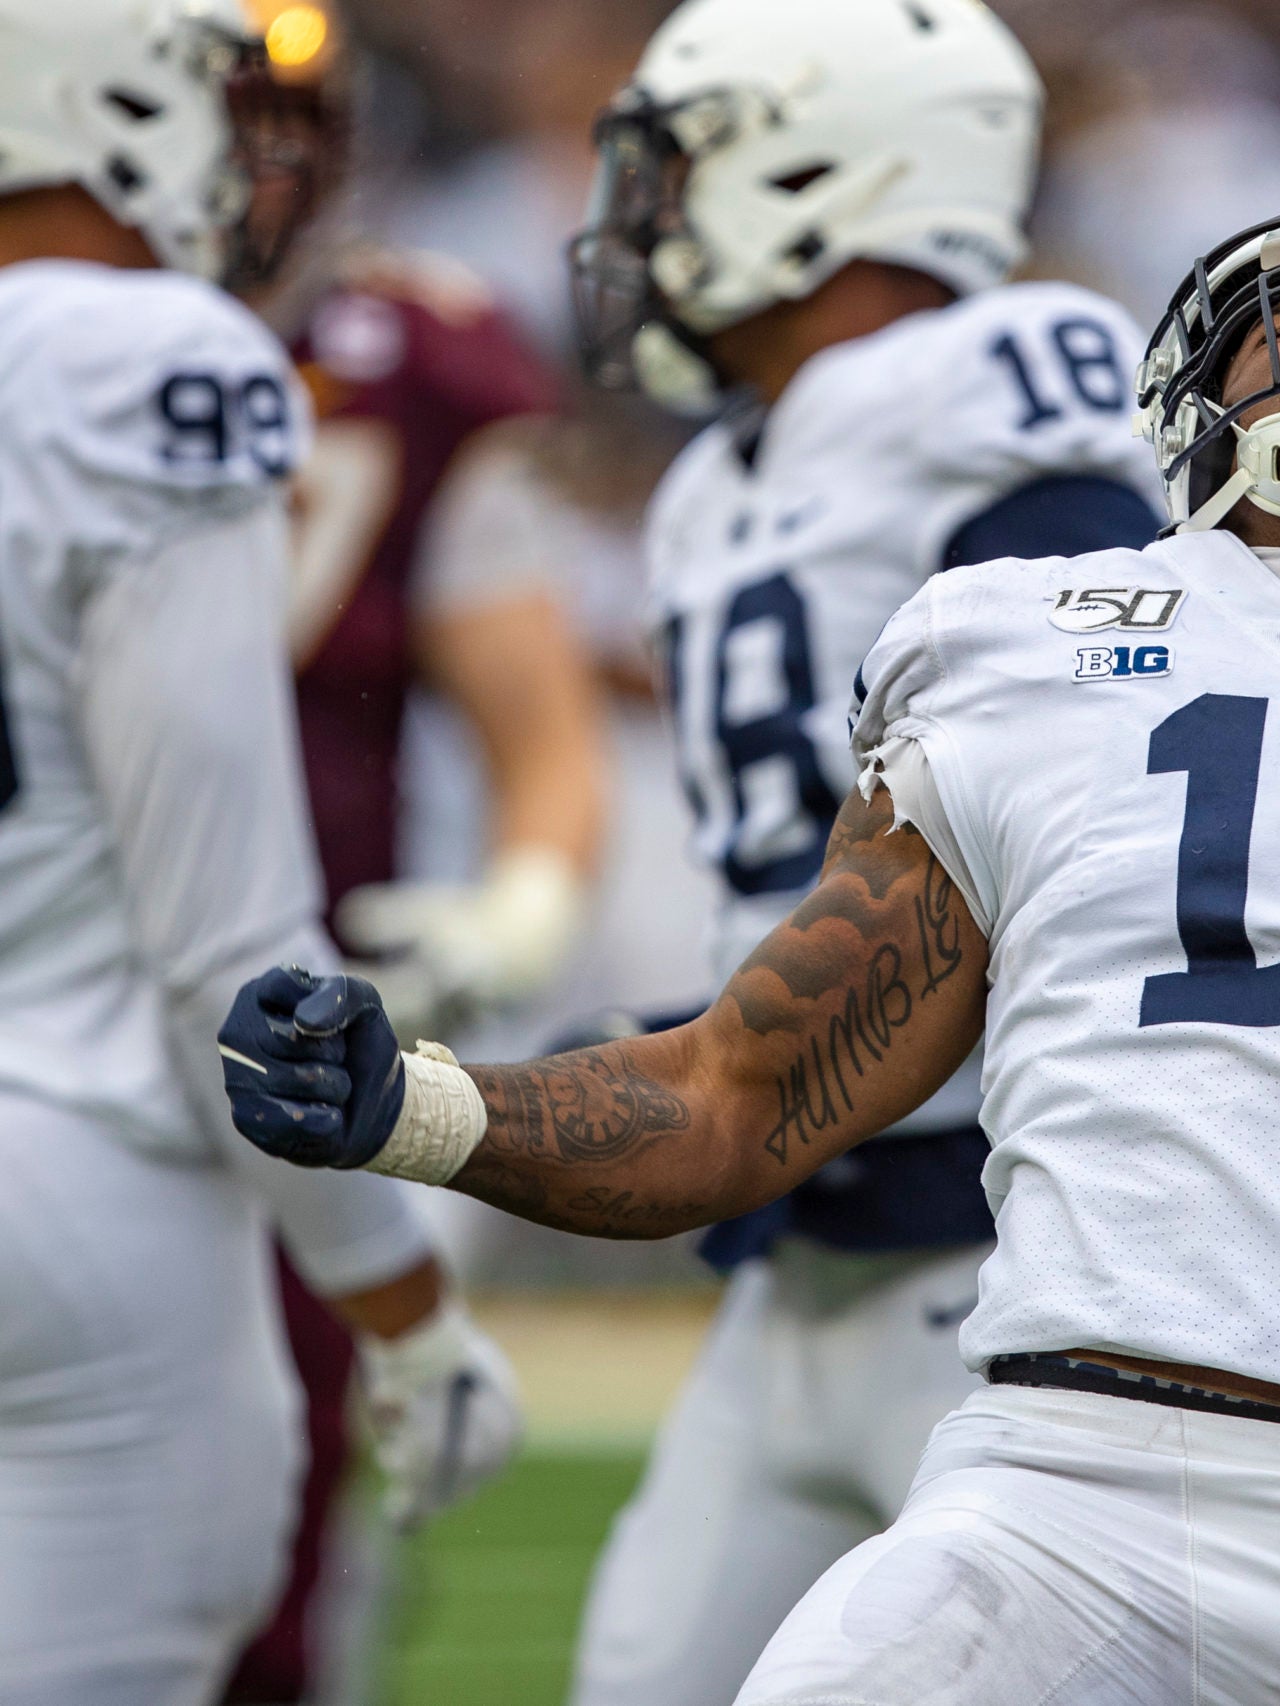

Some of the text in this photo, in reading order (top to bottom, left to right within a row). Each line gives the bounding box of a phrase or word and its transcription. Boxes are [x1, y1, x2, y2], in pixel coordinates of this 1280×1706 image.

[160, 373, 290, 478] 99
[990, 318, 1126, 430] 18
[1054, 587, 1184, 629] 150
[763, 853, 962, 1166] HUMBLE
